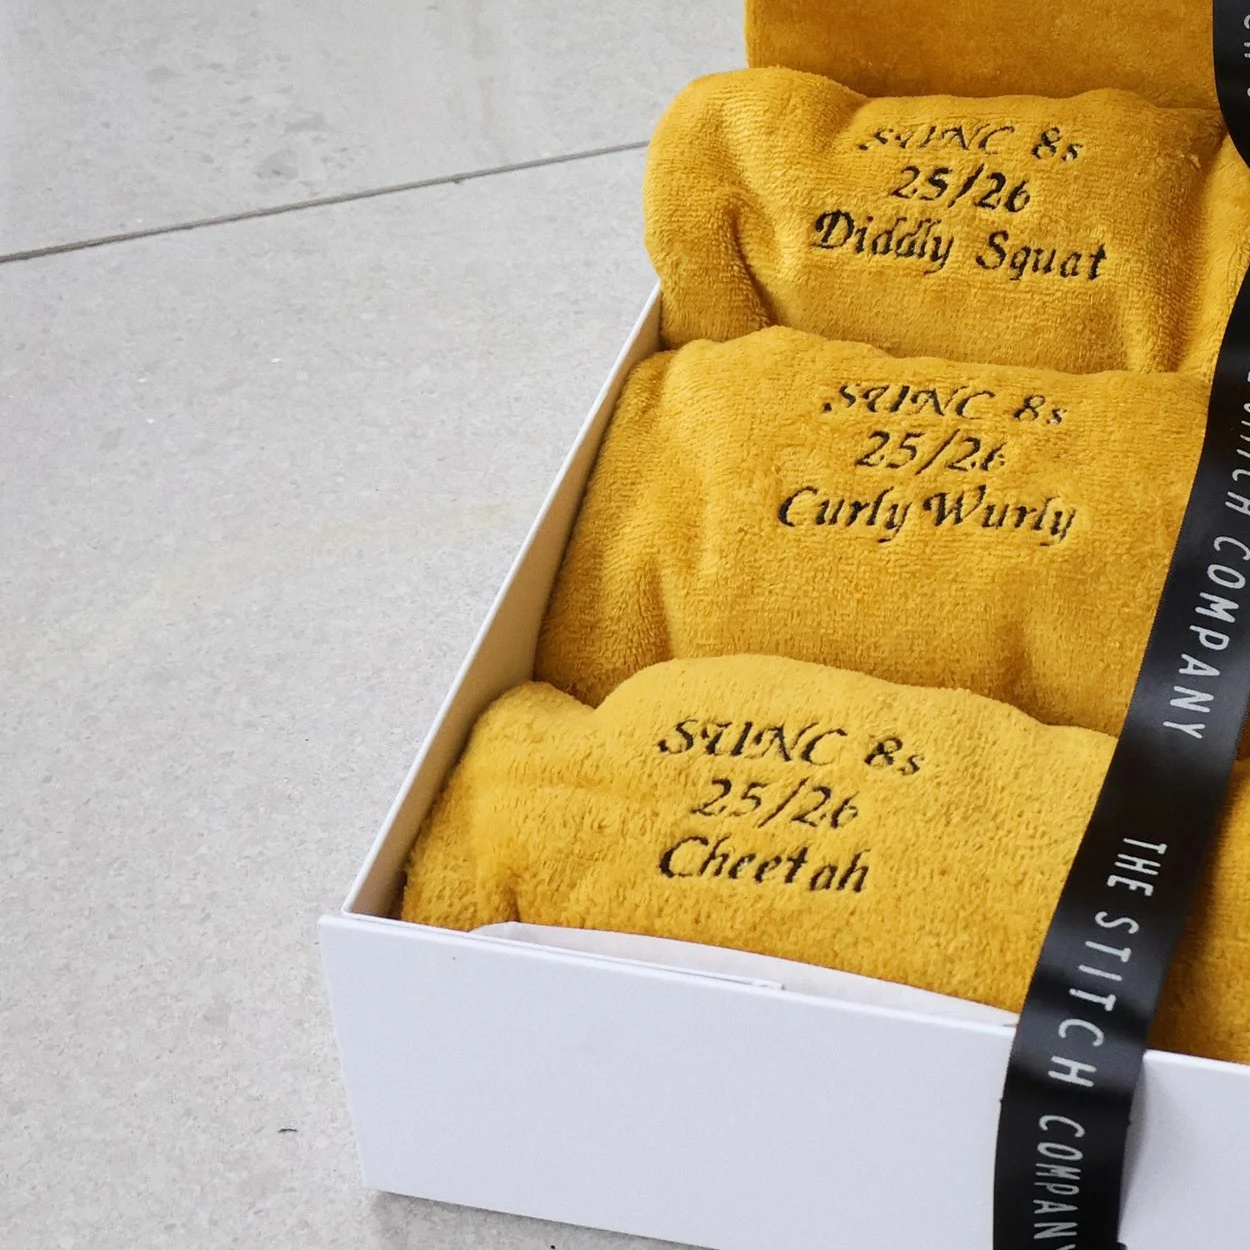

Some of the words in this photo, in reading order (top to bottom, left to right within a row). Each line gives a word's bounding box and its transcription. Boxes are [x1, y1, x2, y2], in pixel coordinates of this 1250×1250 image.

[1031, 126, 1084, 163] 8s
[890, 162, 1033, 213] 25/26
[811, 209, 955, 276] Diddly
[975, 230, 1108, 282] Squat
[1013, 394, 1068, 426] 8s
[856, 429, 1007, 475] 25/26
[777, 485, 914, 543] Curly
[923, 484, 1077, 547] Wurly
[657, 718, 848, 766] SUNC
[864, 736, 925, 776] 8s
[689, 776, 860, 830] 25/26
[657, 832, 872, 893] Cheetah
[1107, 836, 1167, 897] THE
[1047, 911, 1140, 1088] STITCH
[1032, 1114, 1086, 1250] COMPAN
